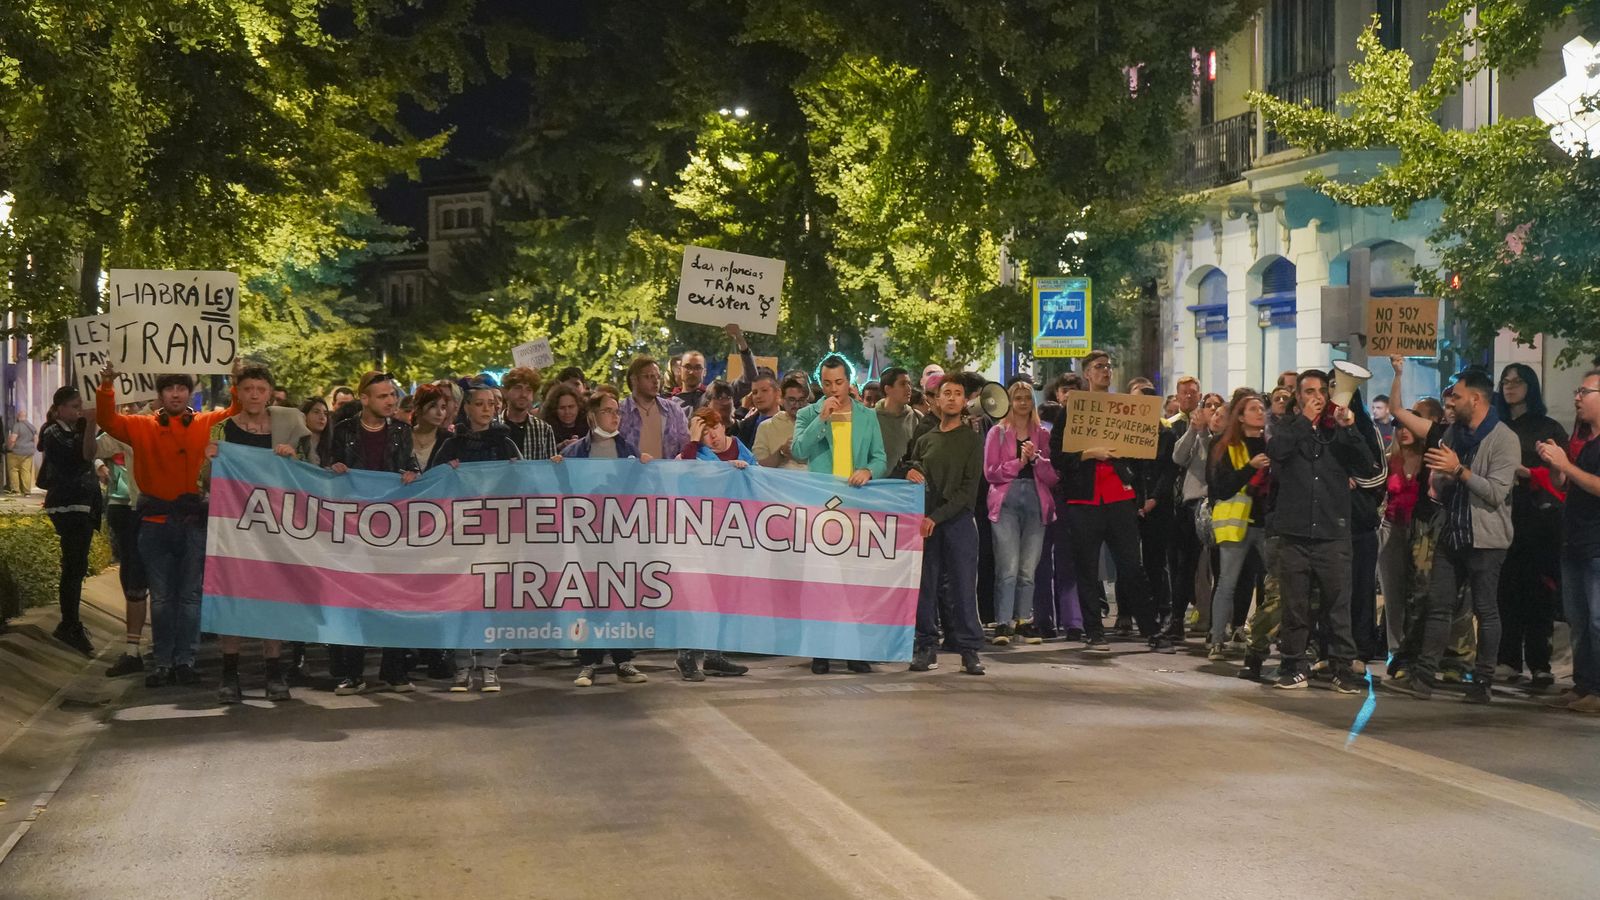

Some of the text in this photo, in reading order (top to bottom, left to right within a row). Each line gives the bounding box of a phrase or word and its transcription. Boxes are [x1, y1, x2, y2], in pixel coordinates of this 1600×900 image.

[690, 254, 714, 272] Las
[115, 276, 235, 313] HABRÁ LEY
[704, 279, 756, 296] TRANS
[687, 292, 751, 311] existen
[1375, 306, 1420, 321] NO SOY
[1049, 318, 1078, 330] TAXI
[1375, 321, 1436, 337] UN TRANS
[115, 320, 236, 367] TRANS
[1371, 336, 1439, 352] SOY HUMANO
[75, 349, 110, 368] TAM
[119, 372, 155, 396] BIN
[1073, 399, 1137, 416] NI EL PSOE
[1072, 414, 1084, 425] ES
[1088, 416, 1101, 426] DE
[1070, 425, 1156, 447] NI YO SOY HETERO
[236, 487, 898, 560] AUTODETERMINACIÓN
[471, 560, 674, 610] TRANS
[483, 621, 656, 644] granada visible
